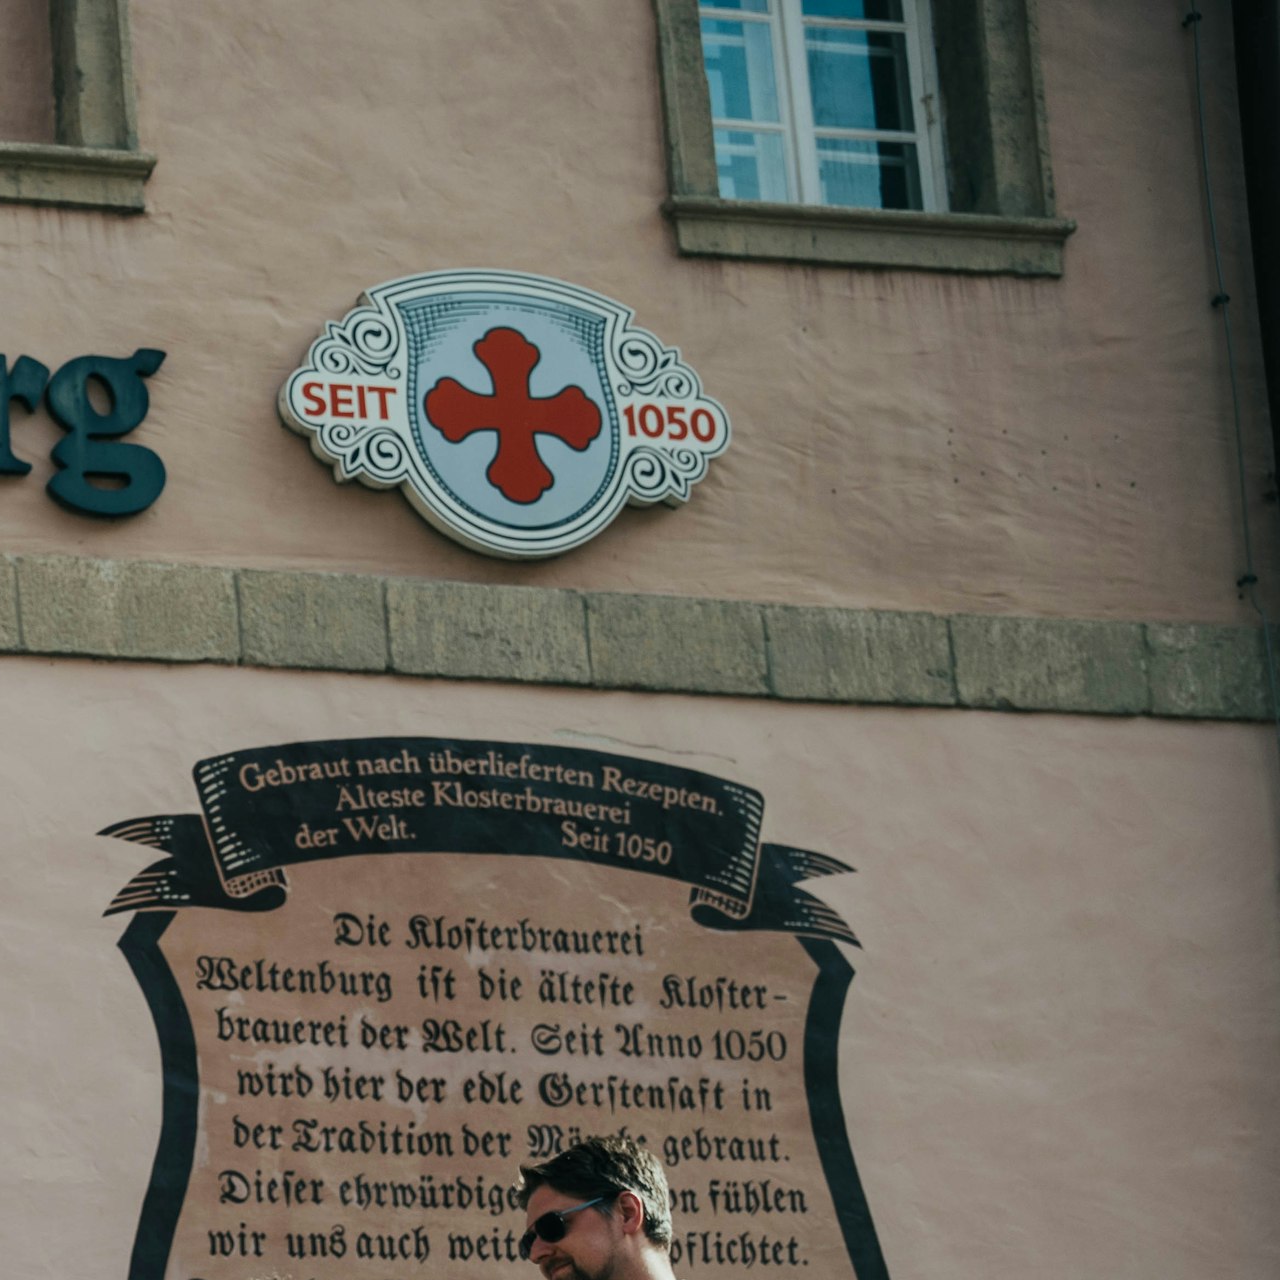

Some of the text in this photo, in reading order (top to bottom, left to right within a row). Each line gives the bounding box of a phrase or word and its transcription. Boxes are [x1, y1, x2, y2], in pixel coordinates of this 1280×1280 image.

[301, 382, 716, 444] SEIT 1050
[239, 750, 724, 816] Gebraut nach überlieferten Rezepten.
[336, 780, 631, 824] Älteste Klosterbrauerei
[295, 814, 672, 865] der Welt. Seit 1050
[333, 913, 391, 946] Die
[195, 956, 392, 1003] Weltenburg
[479, 967, 522, 1001] die
[215, 1006, 788, 1062] brauerei der Welt. Seit Anno 1050
[237, 1063, 313, 1099] wird
[322, 1067, 385, 1104] hier
[396, 1069, 447, 1104] der
[462, 1071, 523, 1105] edle
[742, 1078, 773, 1112] in
[232, 1115, 283, 1151] der
[291, 1119, 454, 1157] Tradition
[460, 1123, 512, 1159] der
[663, 1127, 791, 1167] gebraut.
[339, 1173, 521, 1216] ehrwürdige
[708, 1179, 809, 1216] fühlen
[208, 1222, 267, 1257] wir
[286, 1224, 346, 1260] uns
[356, 1225, 430, 1264] auch
[669, 1230, 809, 1270] pflichtet.
